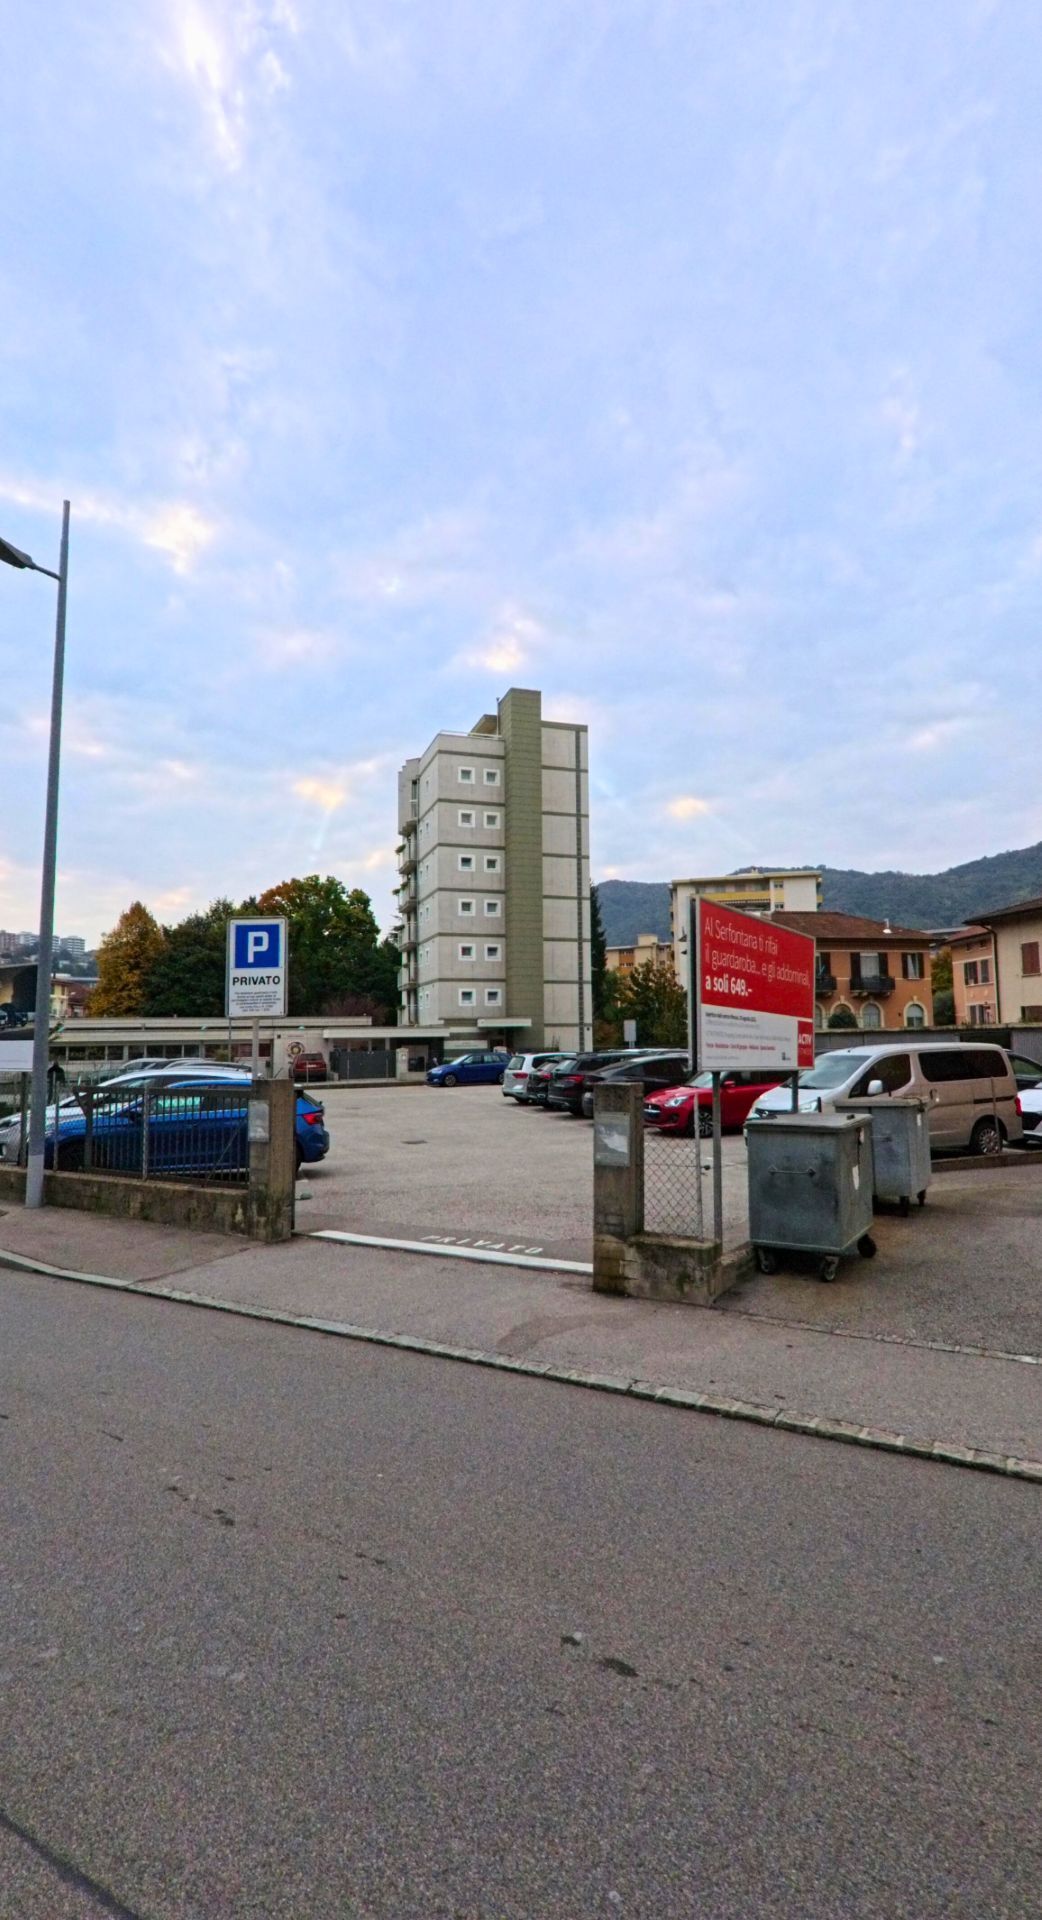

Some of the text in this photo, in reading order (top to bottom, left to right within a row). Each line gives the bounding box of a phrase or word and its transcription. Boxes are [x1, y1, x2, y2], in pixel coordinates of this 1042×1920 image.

[704, 917, 713, 937] Al
[715, 920, 758, 950] Serfontana
[247, 931, 269, 963] P
[232, 976, 281, 986] PRIVATO
[705, 975, 712, 991] a
[713, 973, 729, 993] soli
[420, 1235, 543, 1253] PRIVATO
